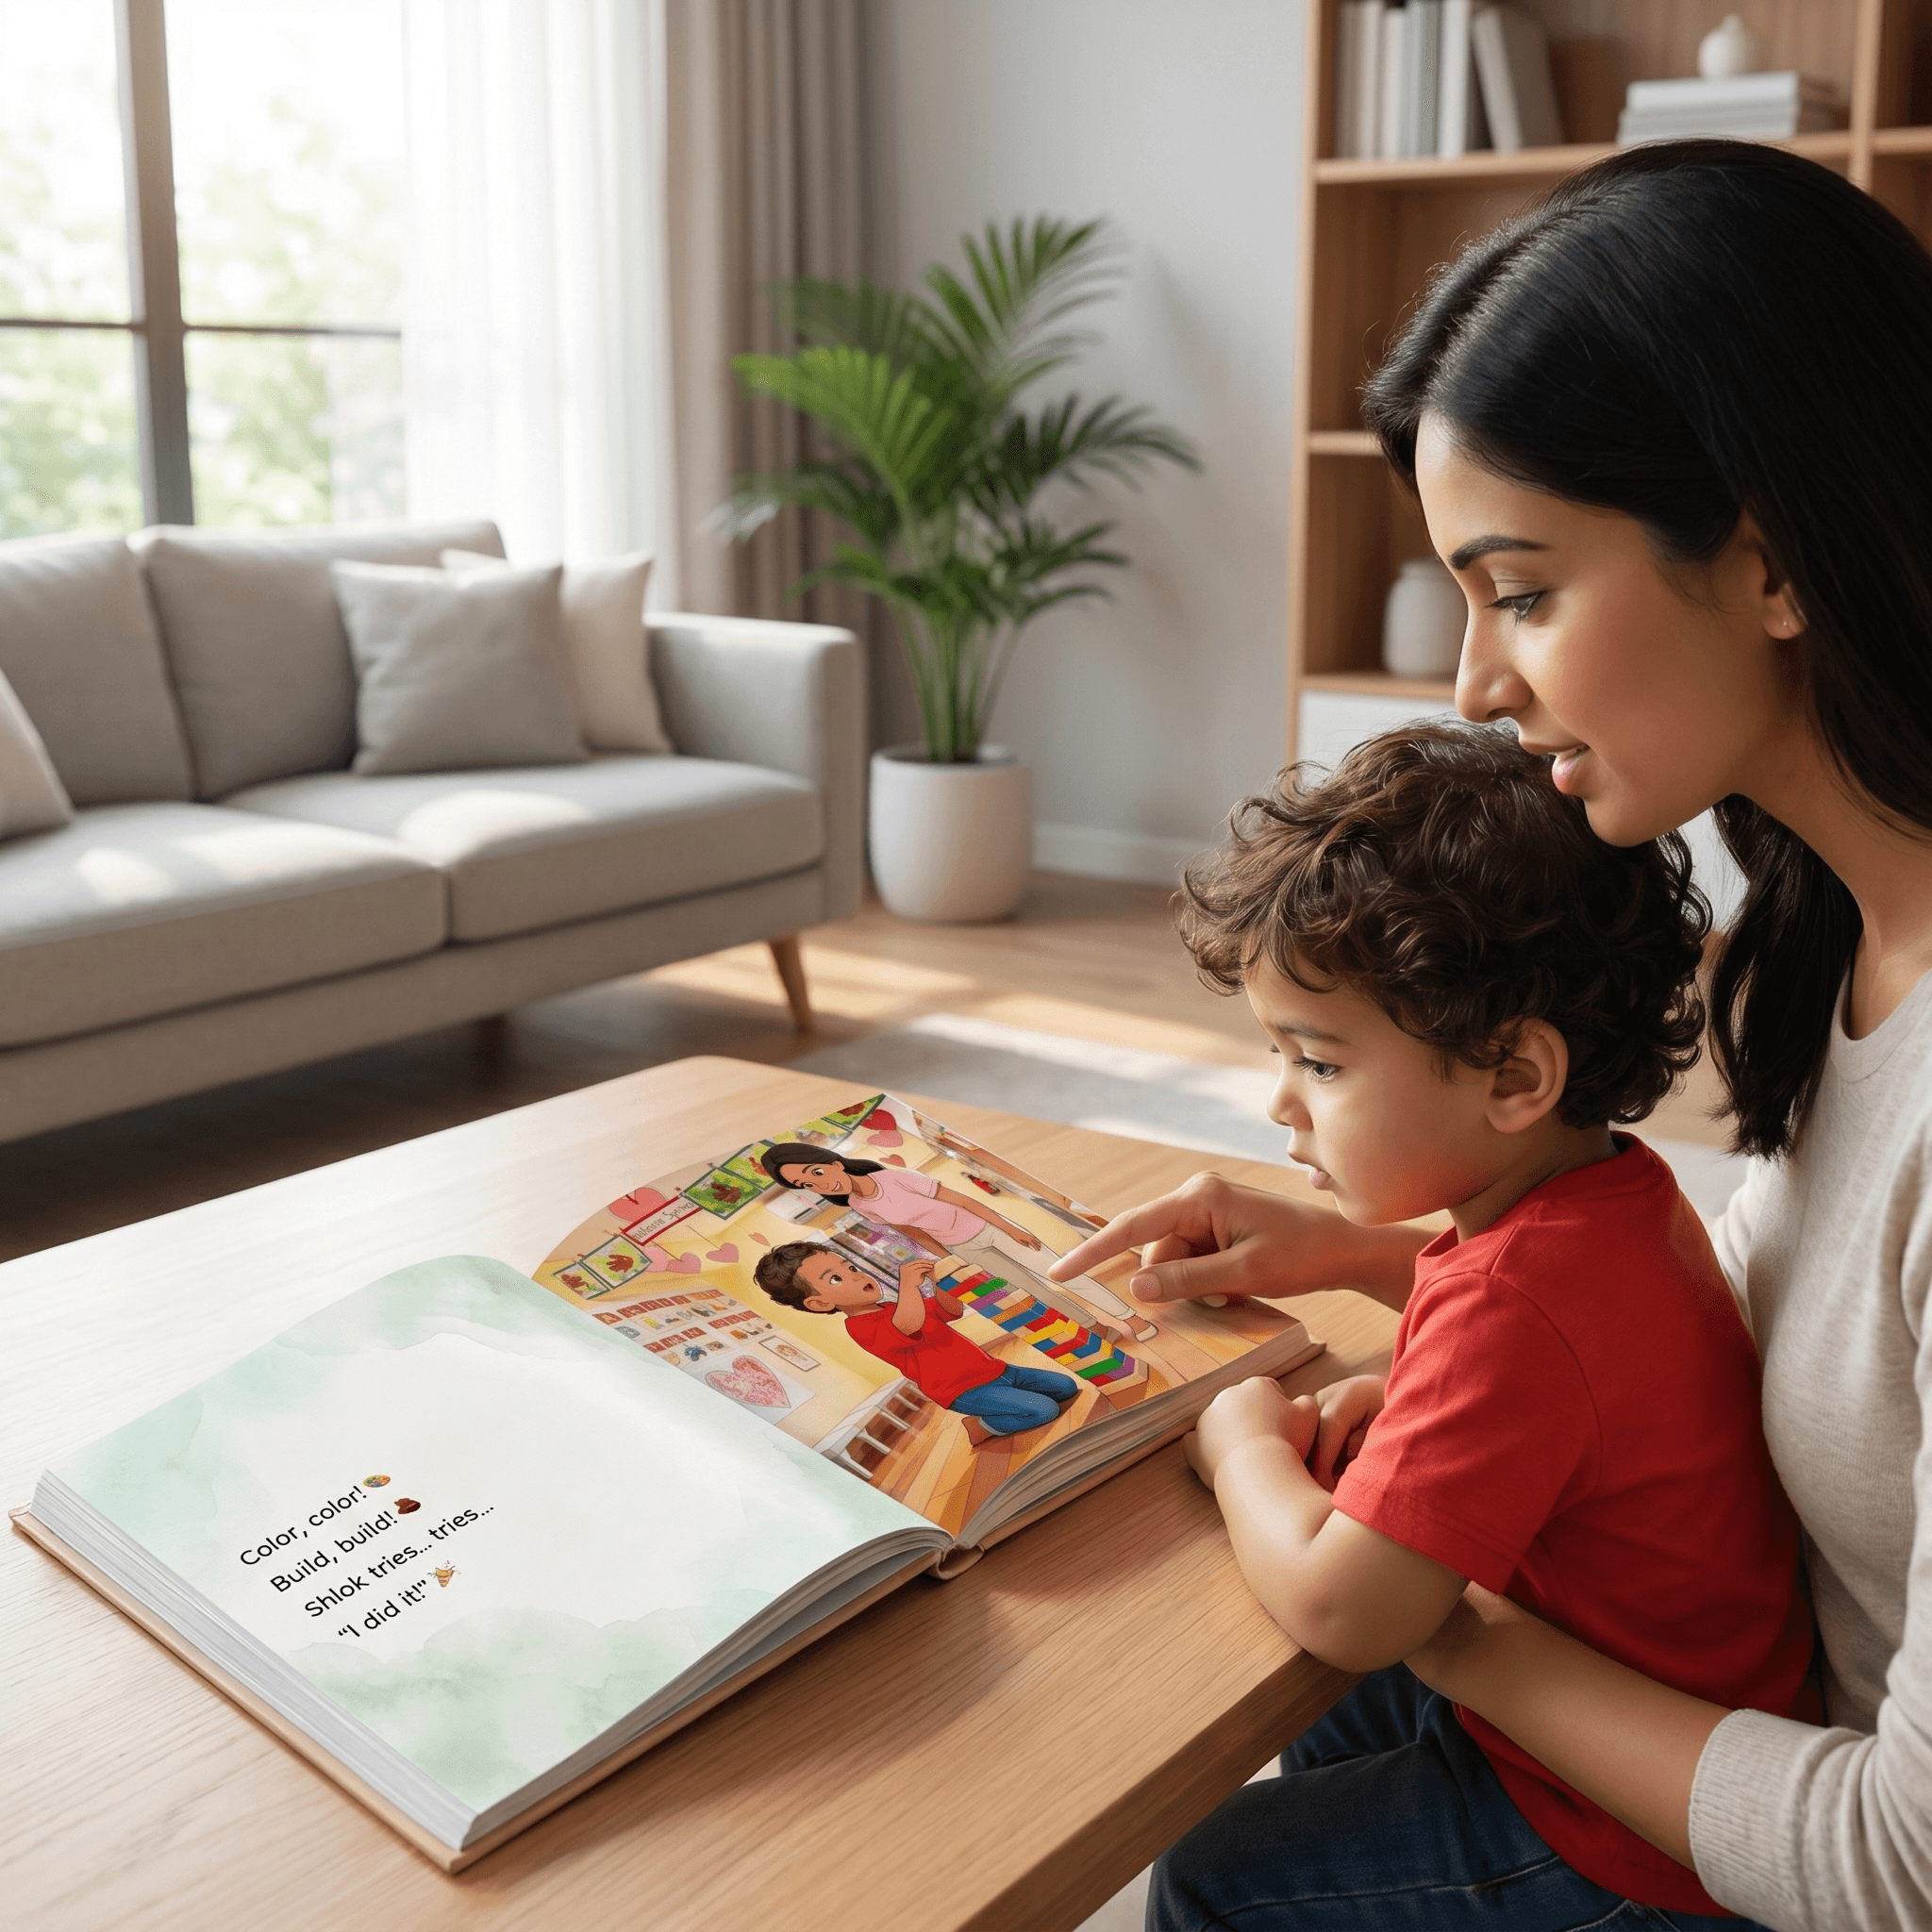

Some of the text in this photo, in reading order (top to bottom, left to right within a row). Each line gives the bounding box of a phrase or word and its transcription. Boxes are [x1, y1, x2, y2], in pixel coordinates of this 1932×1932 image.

[240, 1485, 367, 1565] Color, color!
[270, 1510, 398, 1593] Build, build!
[304, 1507, 494, 1618] Shlok tries... tries...
[363, 1599, 402, 1630] did
